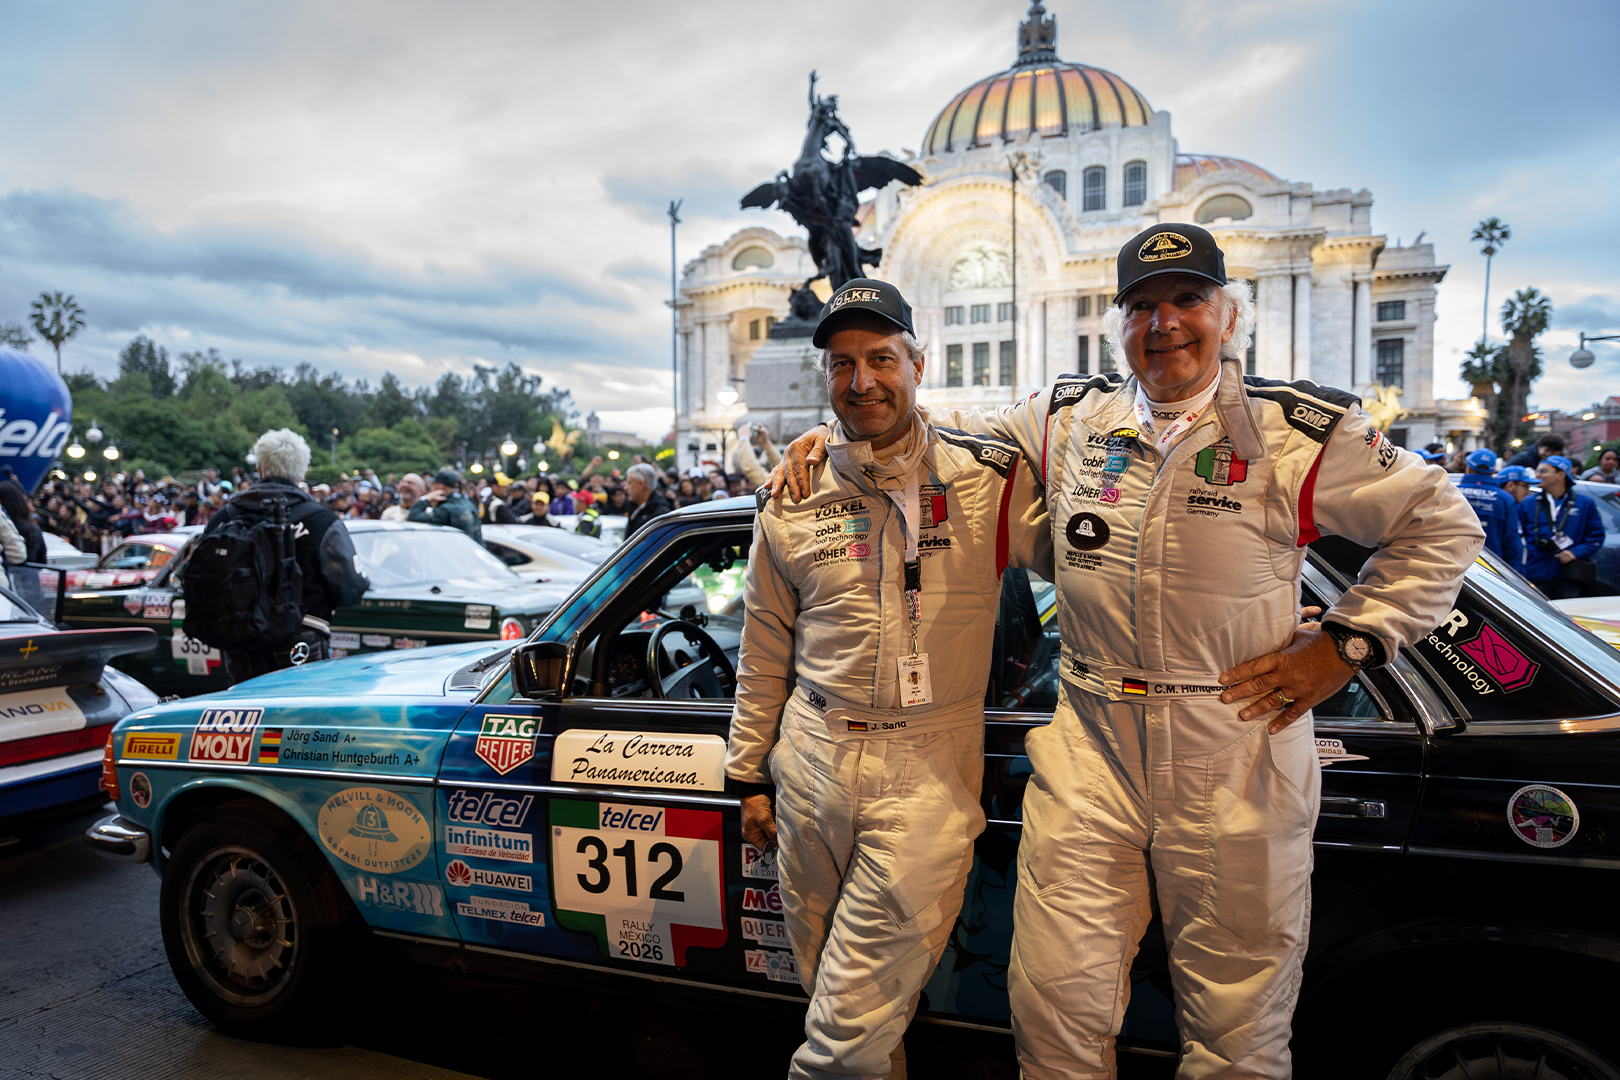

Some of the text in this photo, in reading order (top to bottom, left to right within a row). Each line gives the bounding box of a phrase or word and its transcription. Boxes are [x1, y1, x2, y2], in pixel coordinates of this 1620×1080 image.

[1055, 386, 1083, 399] OMP
[1152, 410, 1187, 420] parc
[1293, 406, 1330, 428] OMP
[981, 448, 1009, 464] OMP
[1082, 456, 1104, 468] cobit
[1091, 470, 1123, 483] technology
[1073, 484, 1100, 498] LÖHER
[1189, 488, 1218, 497] rallyraid
[815, 501, 866, 518] VÖLKEL
[1187, 495, 1242, 511] service
[1187, 508, 1218, 518] Germany
[816, 523, 841, 537] cobit
[829, 533, 868, 542] technology
[814, 548, 846, 562] LÖHER
[1154, 684, 1178, 694] C.M.
[809, 691, 826, 708] OMP
[199, 711, 258, 732] LIQUI
[488, 718, 536, 737] TAG
[871, 721, 907, 730] J. Sand
[287, 729, 357, 743] Jörg Sand A+
[127, 737, 176, 755] PIRELLI
[193, 735, 250, 760] MOLY
[586, 733, 694, 759] La Carrera
[283, 748, 420, 766] Christian Huntgeburth A+
[479, 740, 532, 772] HEUER
[571, 757, 698, 785] Panamericana
[327, 792, 421, 825] MELVILL & MOON
[449, 790, 533, 826] telcel
[366, 810, 377, 827] 3
[600, 806, 664, 832] telcel
[448, 828, 530, 851] infinitum
[327, 836, 422, 868] SAFARI OUTFITTERS
[464, 846, 530, 861] Exceso de Velocidad
[576, 836, 685, 903] 312
[475, 871, 530, 890] HUAWEI
[358, 876, 413, 906] H&R
[460, 905, 541, 925] TELMEX telcel
[622, 919, 654, 932] RALLY
[619, 930, 661, 944] MÉXICO
[618, 940, 664, 961] 2026
